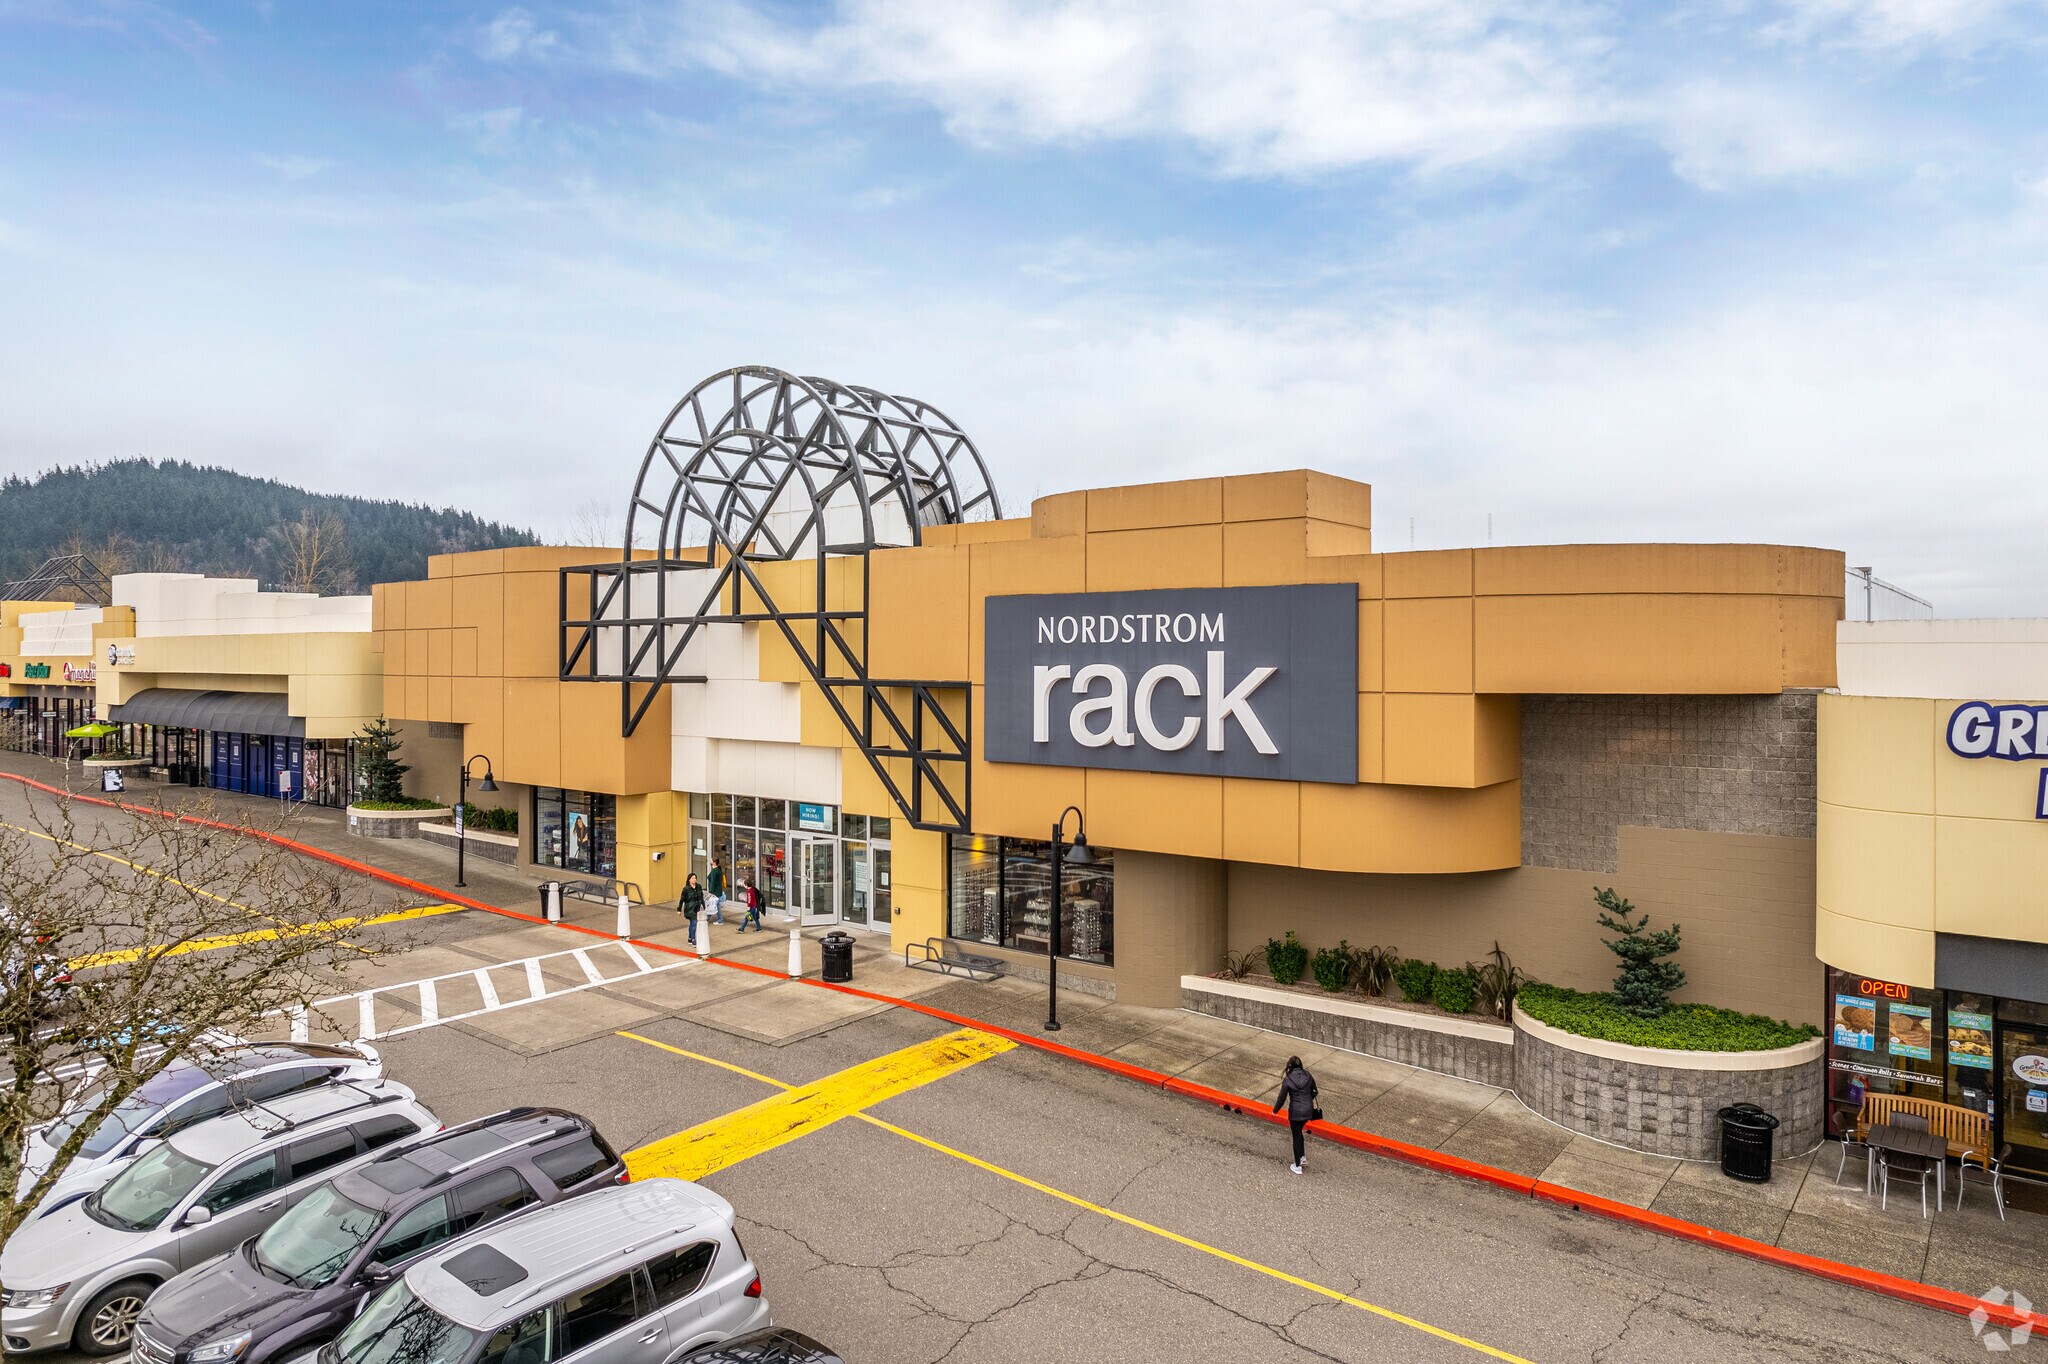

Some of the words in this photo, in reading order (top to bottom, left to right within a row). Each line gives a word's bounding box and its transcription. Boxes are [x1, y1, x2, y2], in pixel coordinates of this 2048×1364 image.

[1037, 612, 1225, 644] NORDSTROM
[1033, 650, 1280, 755] rack
[1860, 980, 1908, 999] OPEN
[1832, 1061, 1850, 1070] Scones
[1852, 1064, 1878, 1074] Cinnamon
[1896, 1072, 1924, 1082] Savannah
